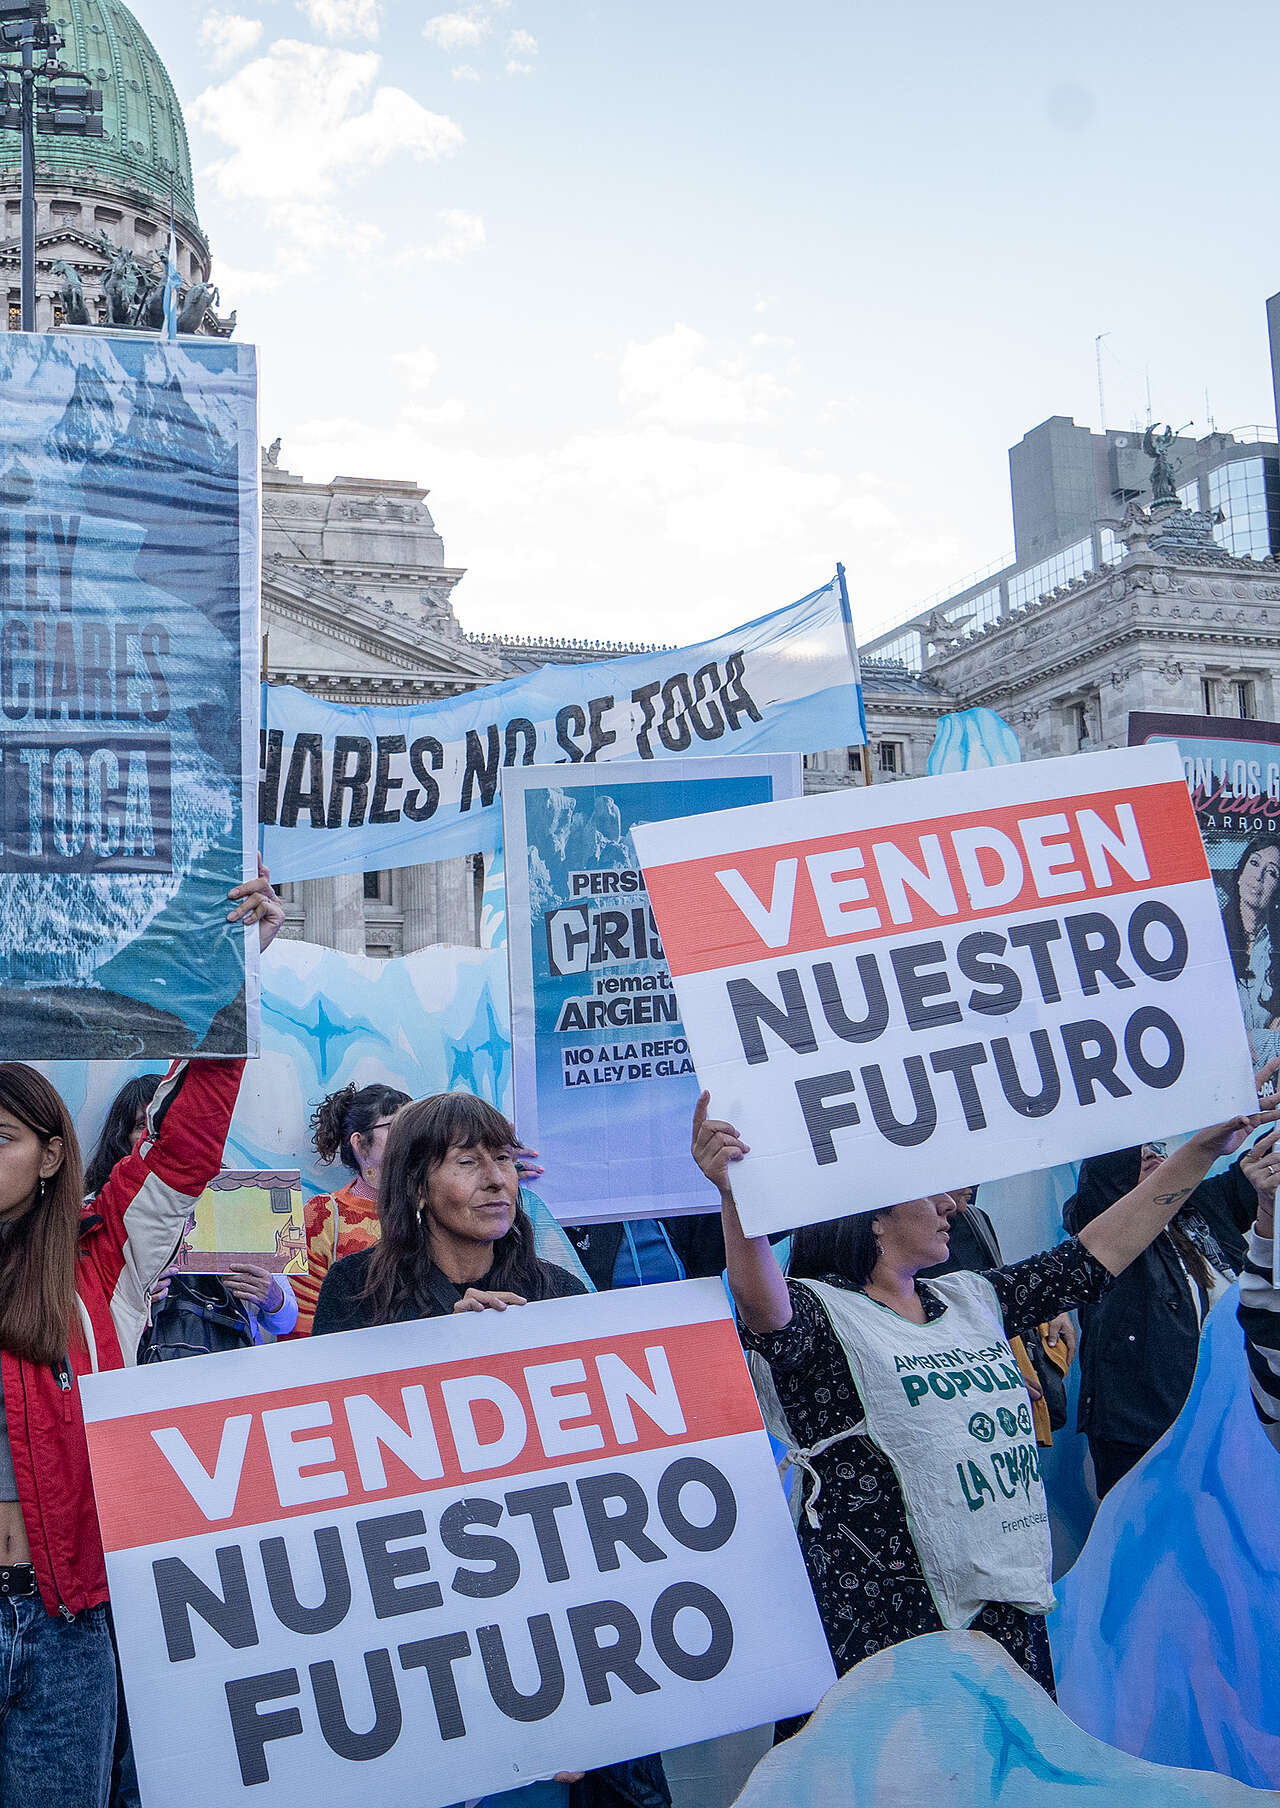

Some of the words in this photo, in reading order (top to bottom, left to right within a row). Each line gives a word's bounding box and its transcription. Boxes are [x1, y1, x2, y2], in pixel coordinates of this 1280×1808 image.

[259, 729, 443, 829] IARES
[631, 650, 762, 759] TOCA
[1221, 758, 1260, 799] LOS
[20, 750, 155, 858] TOCA
[1207, 815, 1276, 831] ARROD
[715, 803, 1151, 948] VENDEN
[559, 993, 678, 1032] ARGEN
[597, 971, 673, 996] remat
[726, 900, 1190, 1066] NUESTRO
[565, 1049, 594, 1066] NO
[598, 1047, 610, 1063] A
[613, 1044, 638, 1062] LA
[641, 1038, 691, 1058] REFO
[565, 1069, 591, 1087] LA
[594, 1065, 624, 1084] LEY
[628, 1062, 652, 1080] DE
[655, 1058, 696, 1077] GLA
[795, 1005, 1186, 1166] FUTURO
[901, 1360, 1026, 1408] POPULA
[151, 1346, 688, 1521] VENDEN
[956, 1460, 996, 1512] LA
[152, 1457, 738, 1663] NUESTRO
[224, 1581, 735, 1786] FUTURO
